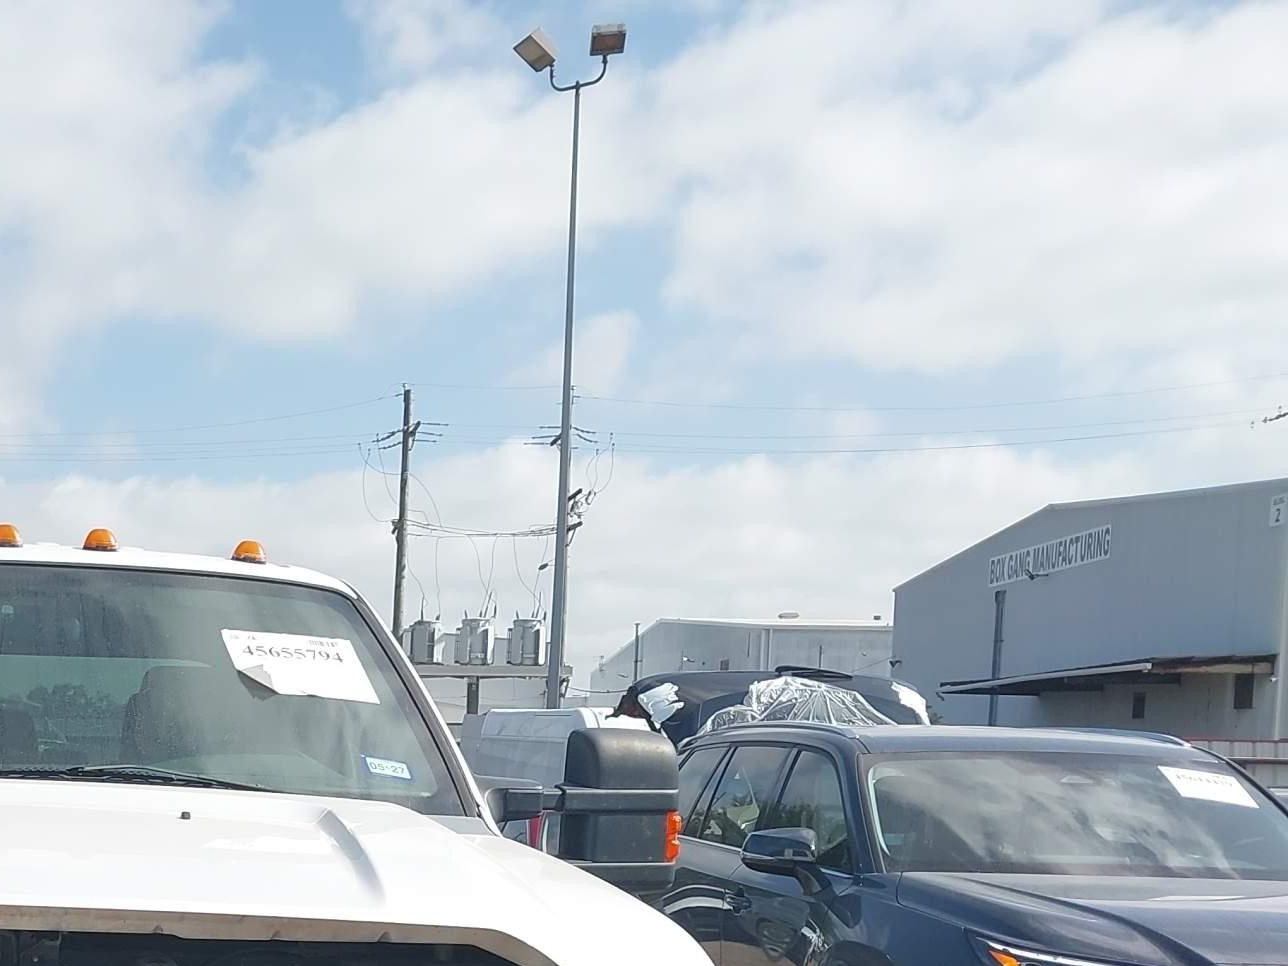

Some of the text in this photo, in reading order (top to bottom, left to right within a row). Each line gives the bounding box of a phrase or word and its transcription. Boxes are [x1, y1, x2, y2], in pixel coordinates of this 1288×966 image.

[989, 527, 1111, 585] BOX GANG MANUFACTURING
[242, 644, 344, 663] 45655794
